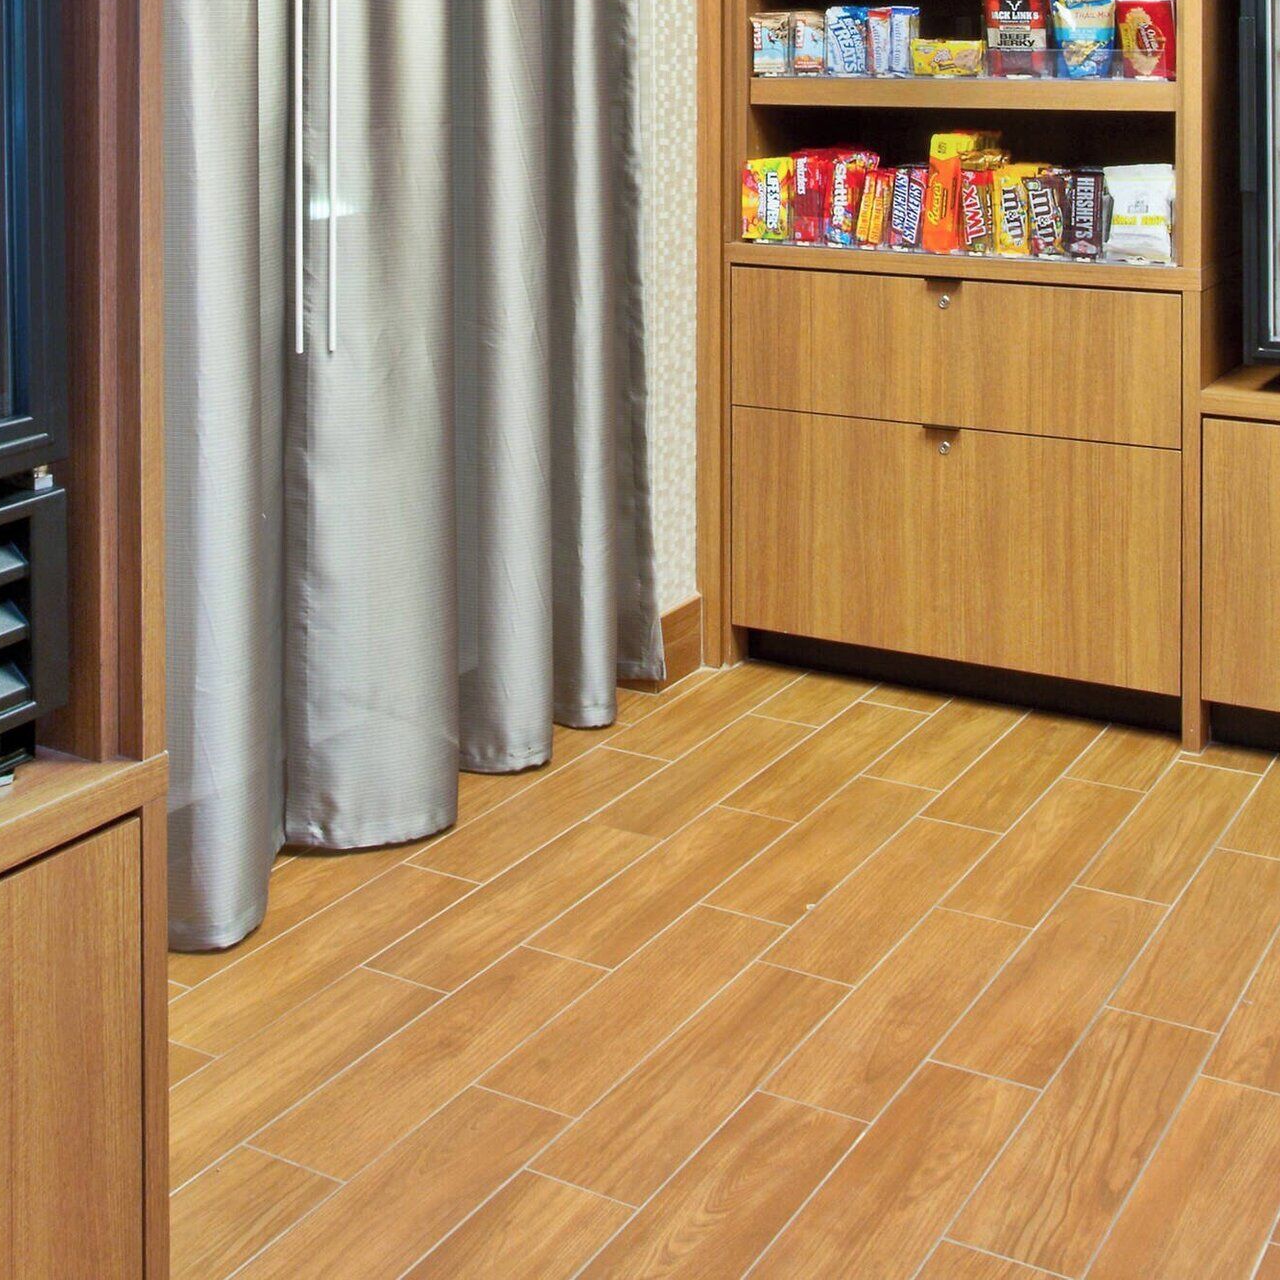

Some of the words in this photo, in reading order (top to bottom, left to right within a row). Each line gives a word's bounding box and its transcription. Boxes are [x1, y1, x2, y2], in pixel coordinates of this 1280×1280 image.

[829, 19, 858, 73] TREATS
[997, 39, 1036, 48] JERKY
[892, 173, 910, 229] SNICKERS
[903, 184, 922, 242] SNICKERS
[964, 185, 987, 245] TWIX
